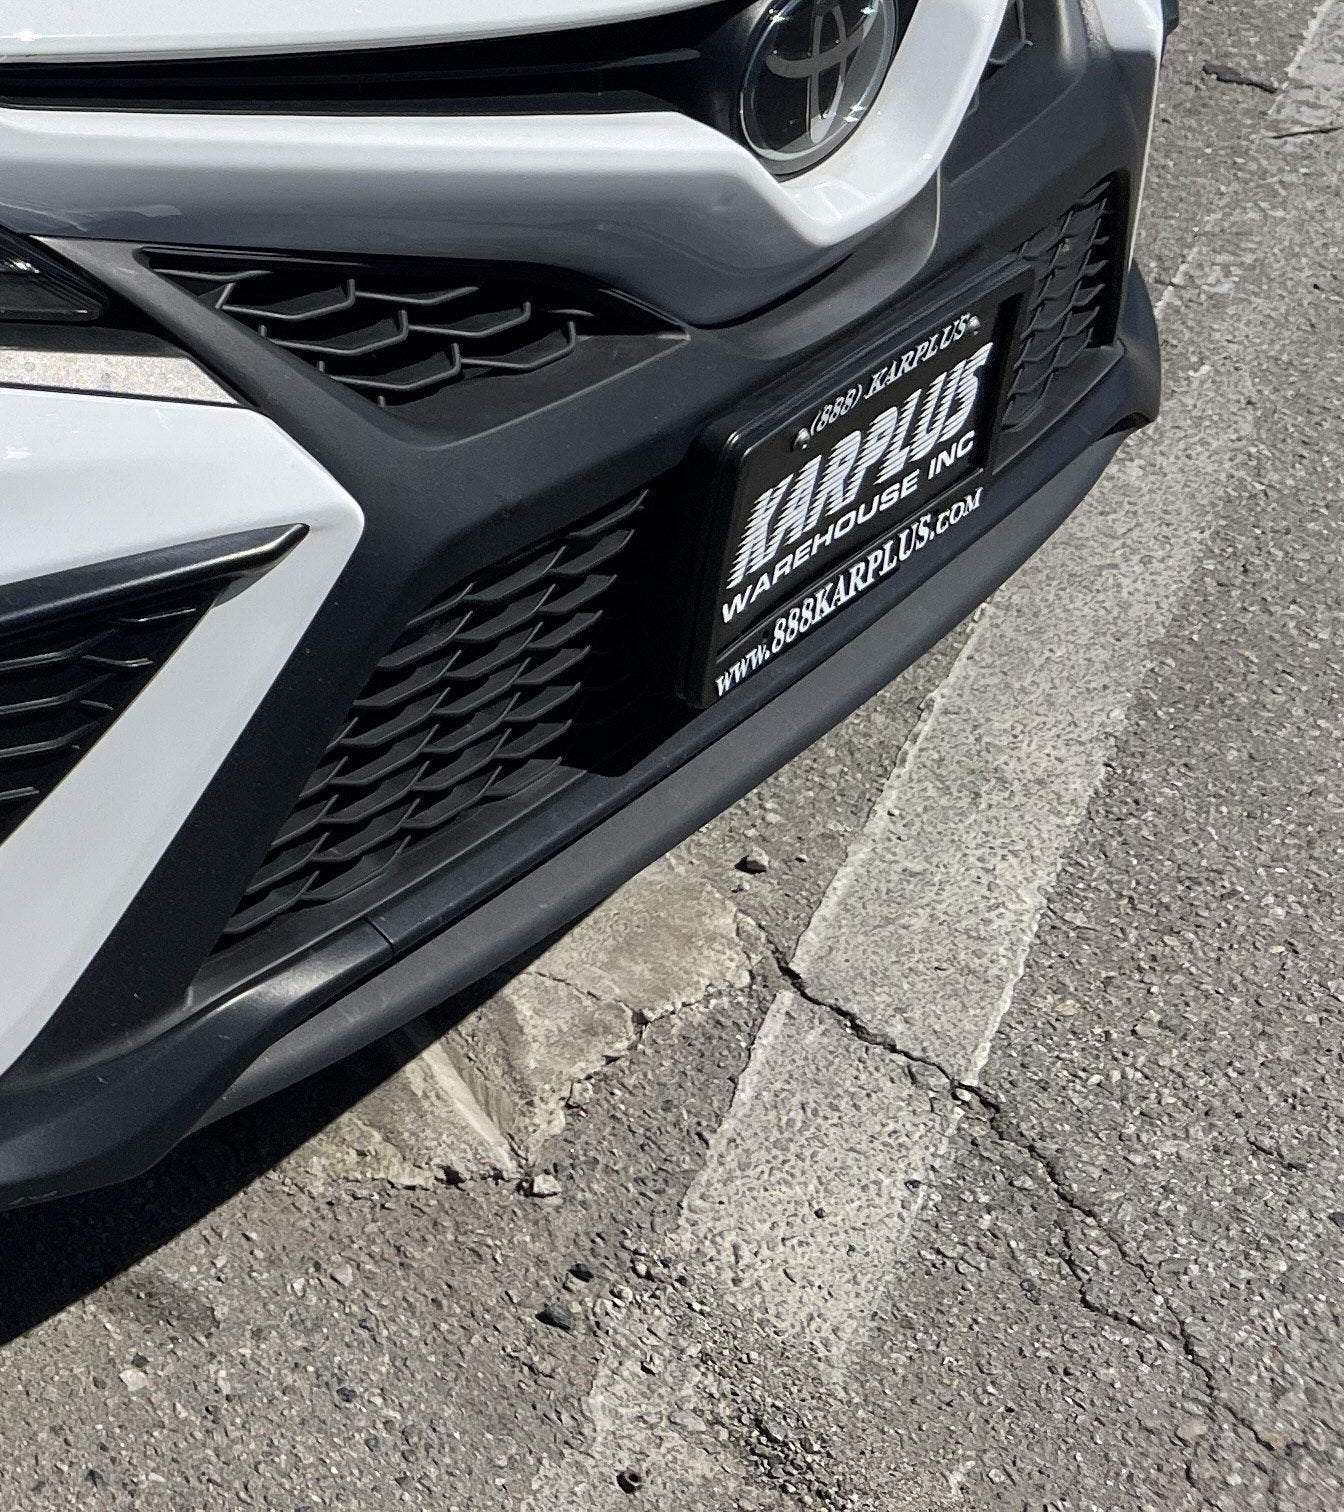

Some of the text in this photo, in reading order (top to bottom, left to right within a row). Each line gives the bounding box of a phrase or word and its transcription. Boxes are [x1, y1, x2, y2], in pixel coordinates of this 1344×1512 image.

[725, 342, 994, 590] KARPLUS
[810, 312, 972, 437] (888) KARPLUS
[721, 430, 976, 624] WAREHOUSE INC
